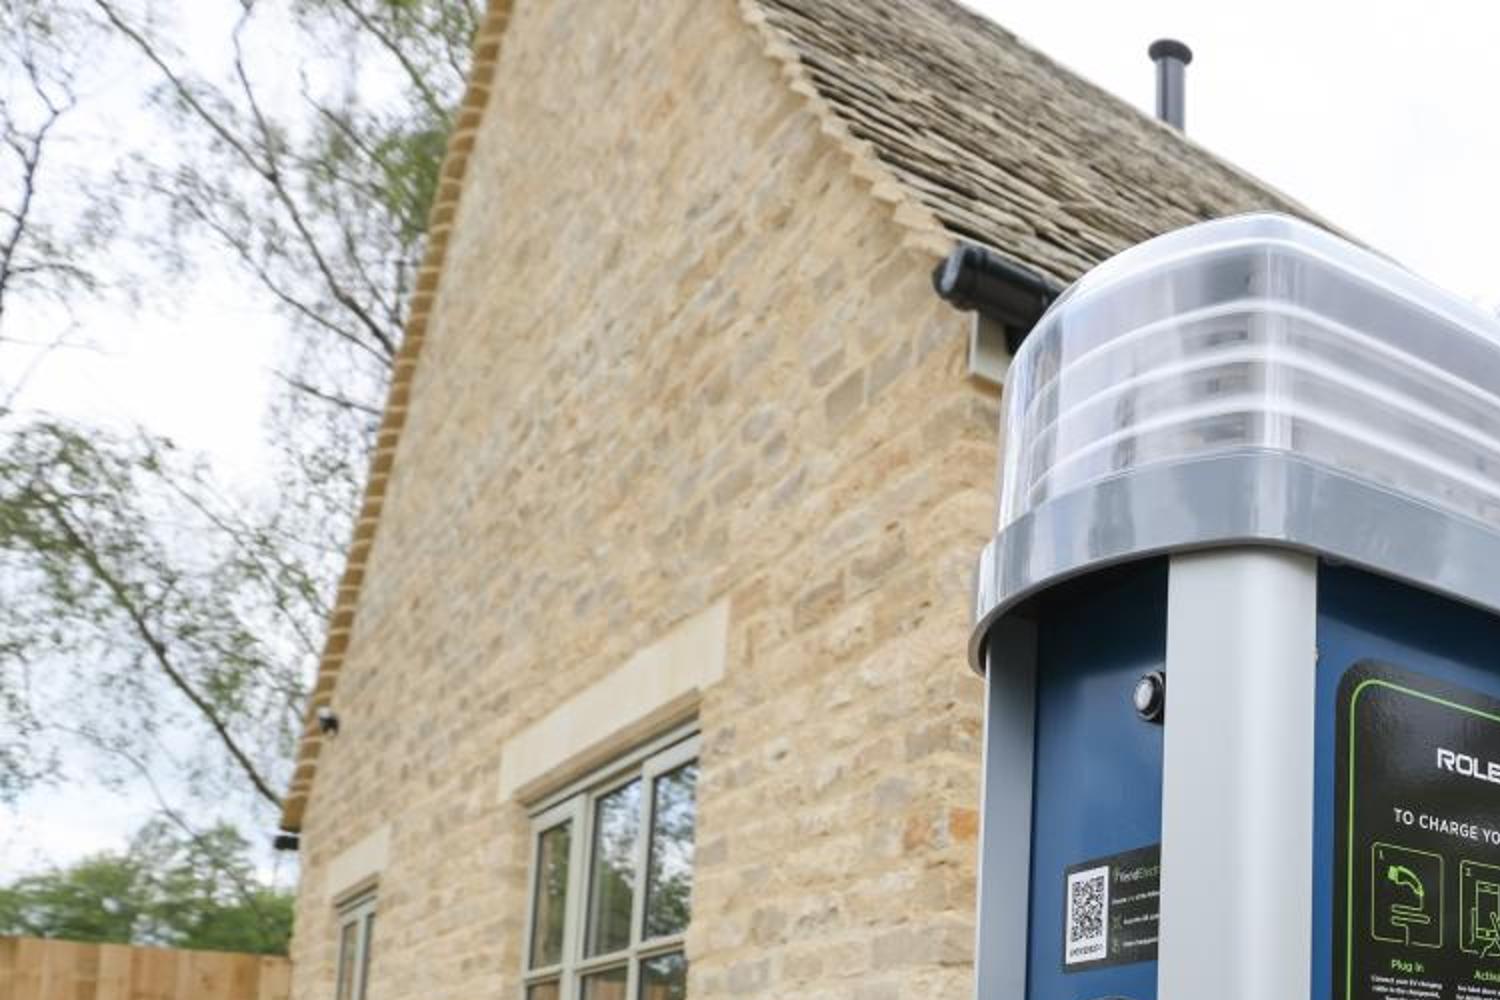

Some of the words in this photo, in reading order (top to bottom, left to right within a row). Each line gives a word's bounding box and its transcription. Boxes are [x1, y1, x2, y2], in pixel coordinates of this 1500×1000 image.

[1393, 807, 1415, 826] TO
[1419, 814, 1479, 841] CHARGE
[1391, 959, 1413, 973] Plug
